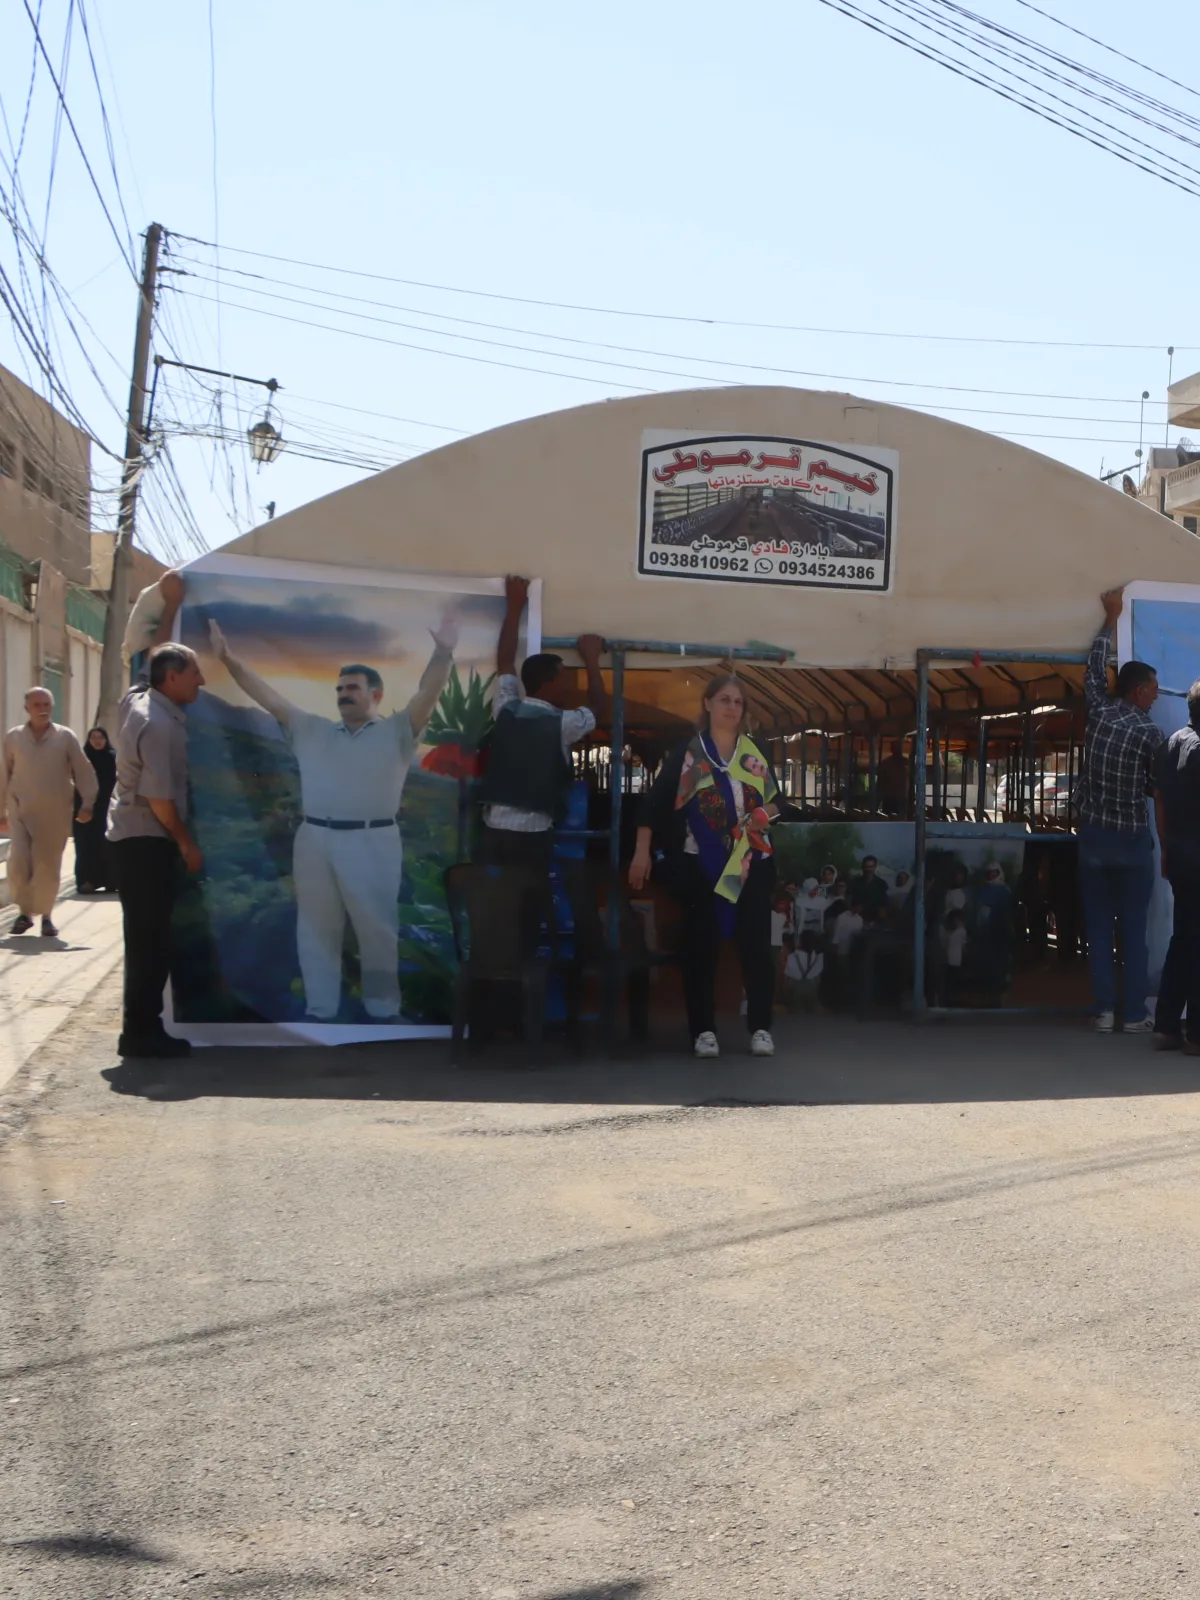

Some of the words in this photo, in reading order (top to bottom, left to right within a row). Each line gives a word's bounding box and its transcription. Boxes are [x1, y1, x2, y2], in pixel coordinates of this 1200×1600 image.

[653, 448, 802, 486] قرموطي
[708, 474, 770, 489] مستلزماتها
[772, 476, 811, 489] كافة
[807, 460, 879, 495] خيم
[692, 537, 748, 552] قرموطي
[751, 542, 789, 556] فادي
[649, 551, 749, 572] 0938810962
[778, 561, 875, 580] 0934524386
